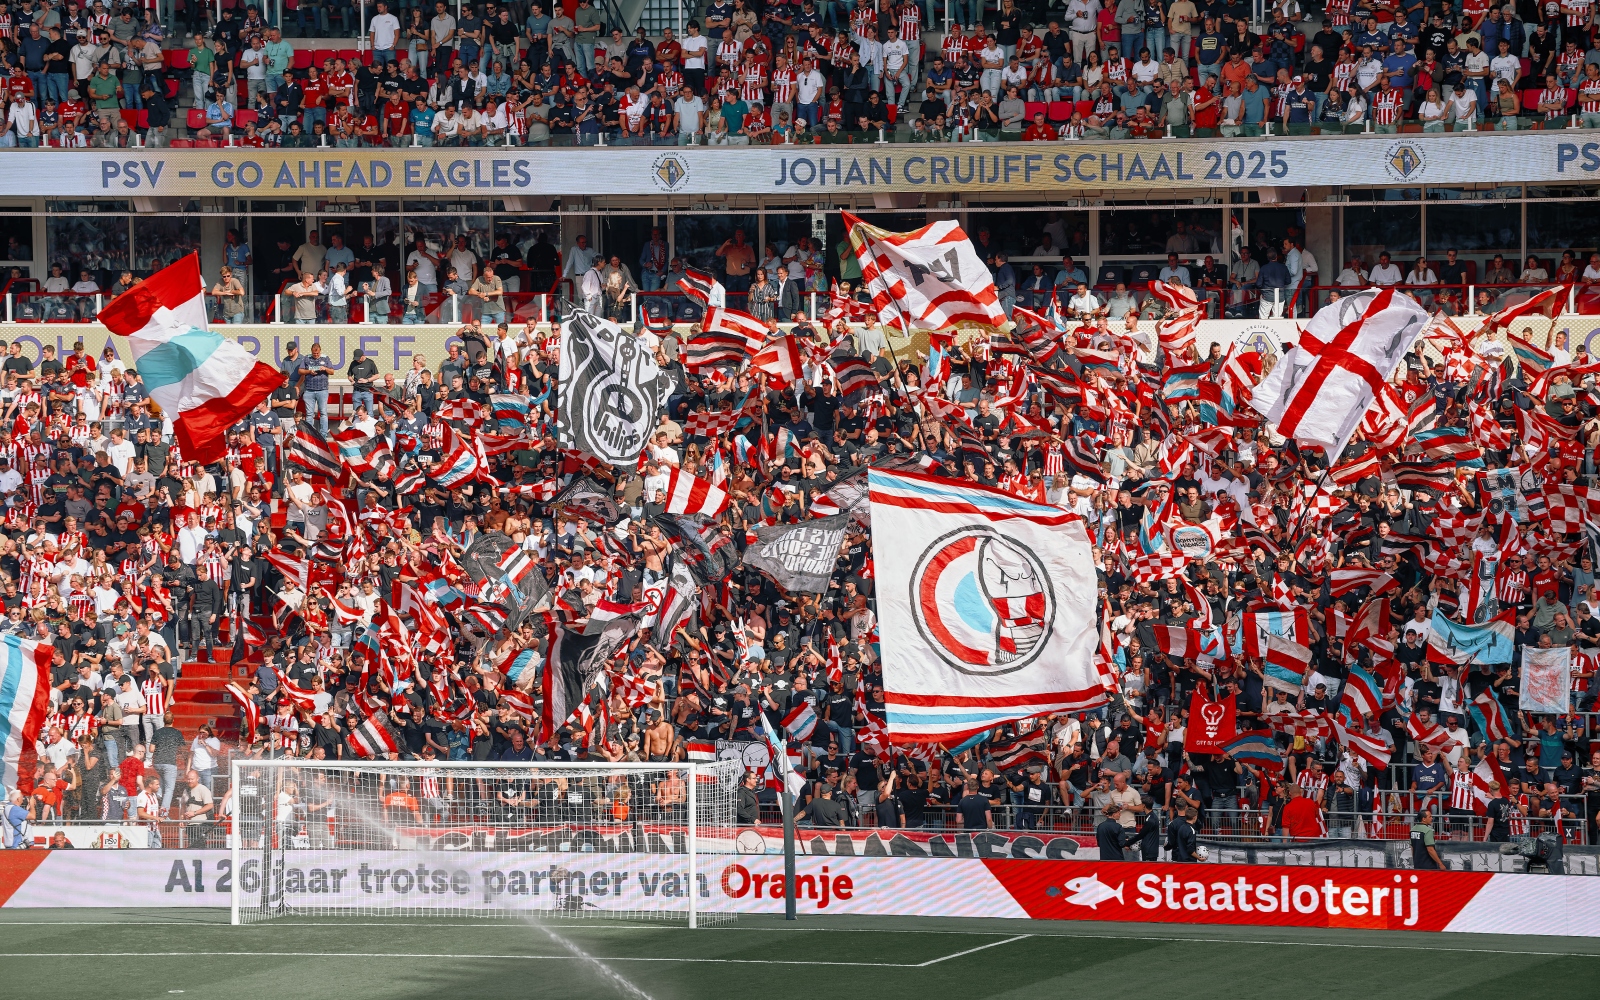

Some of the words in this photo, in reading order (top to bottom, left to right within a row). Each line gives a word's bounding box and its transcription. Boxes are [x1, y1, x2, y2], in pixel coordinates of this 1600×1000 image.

[102, 160, 165, 189] PSV
[210, 160, 263, 189] GO
[274, 160, 393, 188] AHEAD
[405, 159, 531, 188] EAGLES
[775, 156, 892, 186] JOHAN
[904, 154, 1043, 184] CRUIJFF
[1054, 152, 1194, 182] SCHAAL
[1204, 150, 1289, 179] 2025
[1480, 474, 1516, 492] LM
[1565, 828, 1572, 837] X
[164, 859, 205, 894] Al
[216, 859, 262, 894] 26
[268, 860, 348, 903] jaar
[358, 863, 471, 895] trotse
[482, 863, 628, 904] partner
[638, 871, 710, 898] van
[721, 864, 853, 909] Oranje
[1136, 873, 1419, 927] Staatsloterij
